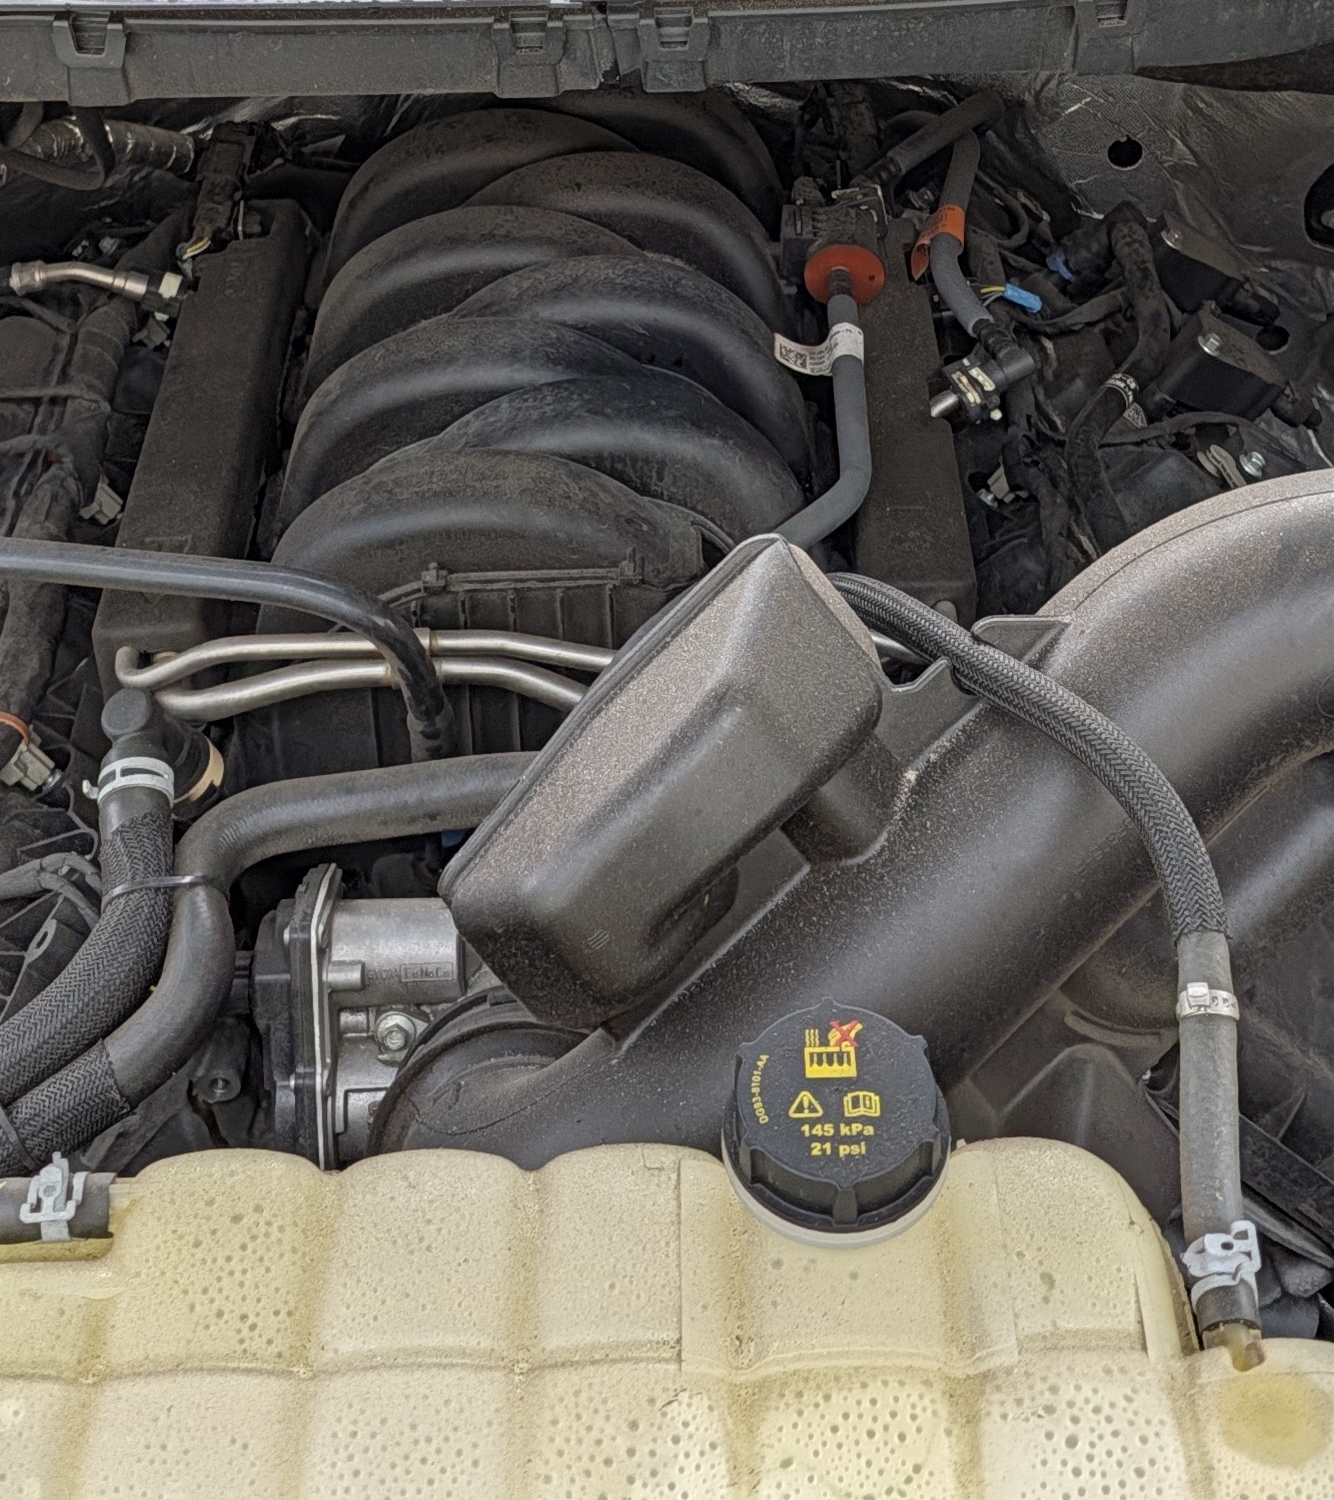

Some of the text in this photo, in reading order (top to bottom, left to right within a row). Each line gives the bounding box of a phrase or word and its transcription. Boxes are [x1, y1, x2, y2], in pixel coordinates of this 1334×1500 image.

[749, 1053, 770, 1125] DG93-8101-AA
[800, 1123, 874, 1138] 145 kPa
[810, 1141, 866, 1157] 21 psi
